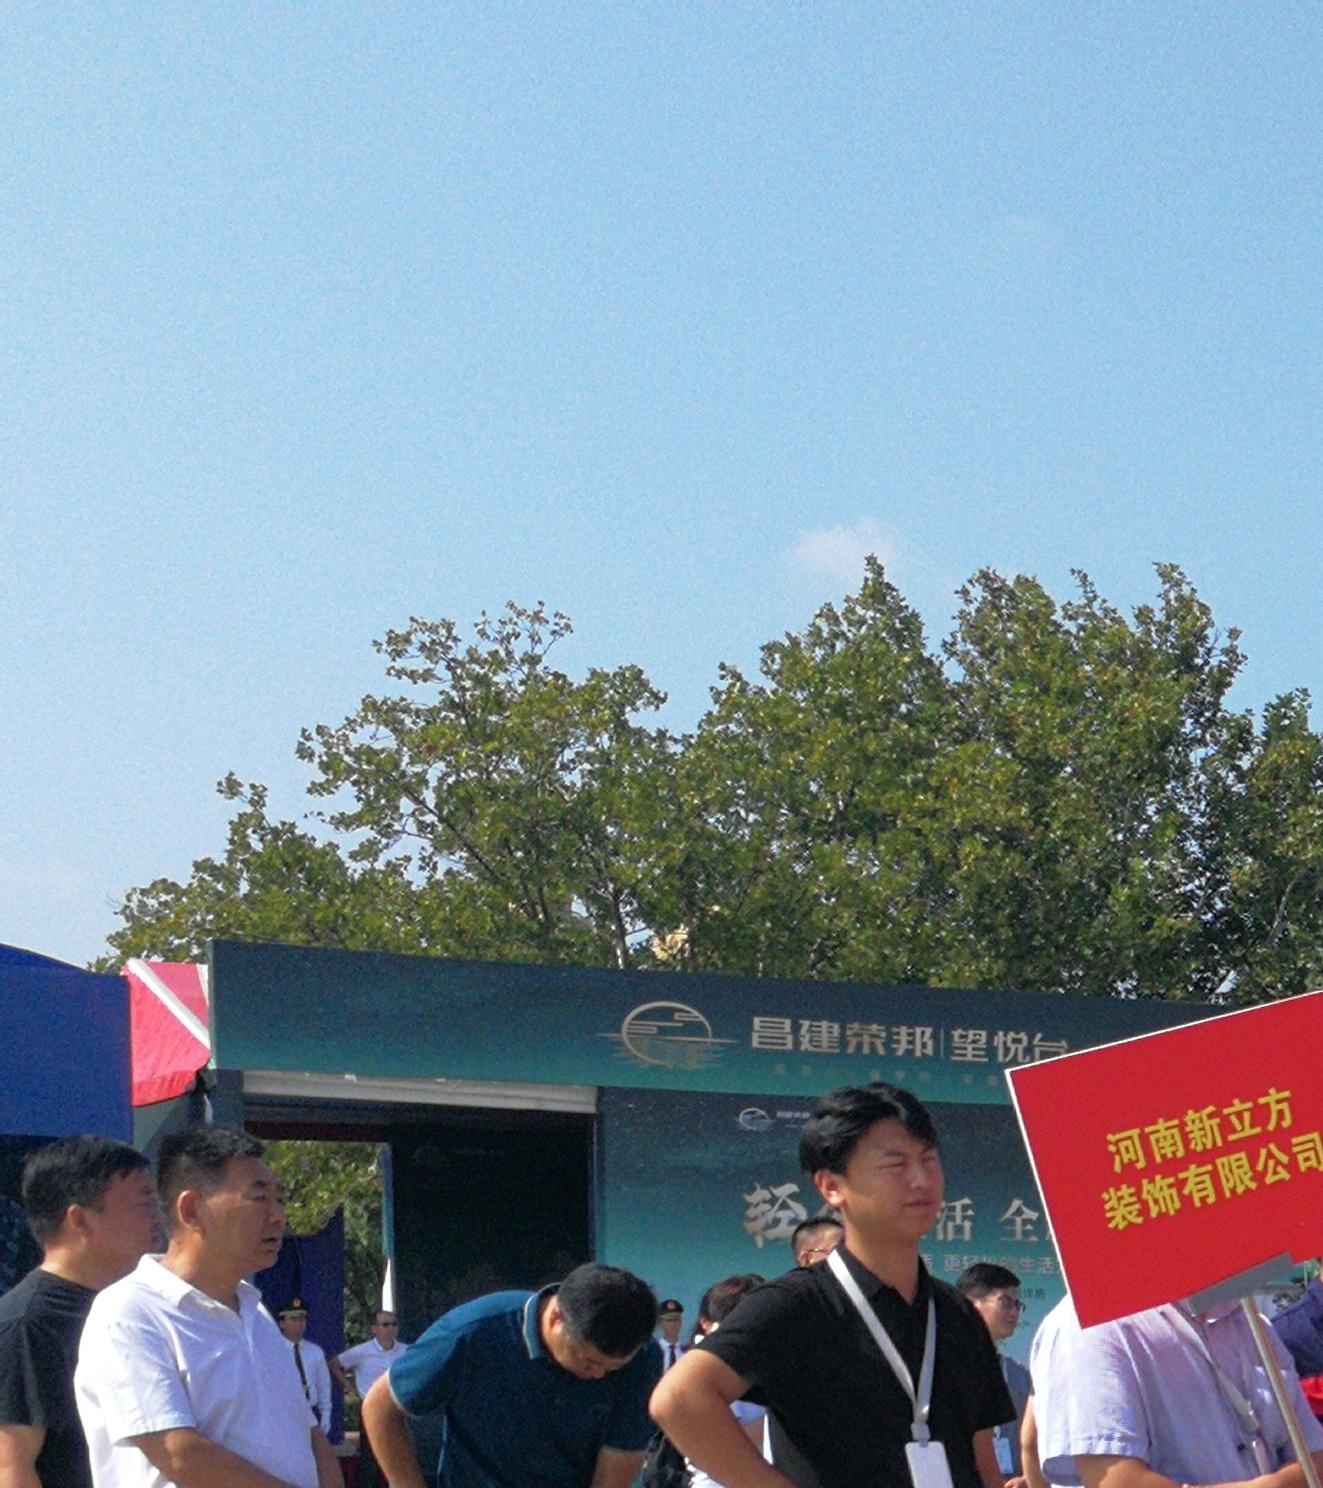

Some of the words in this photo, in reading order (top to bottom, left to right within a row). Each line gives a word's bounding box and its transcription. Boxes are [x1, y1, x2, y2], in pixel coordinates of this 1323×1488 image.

[752, 1016, 934, 1058] 昌建荣邦
[1106, 1087, 1293, 1174] 河南新立方
